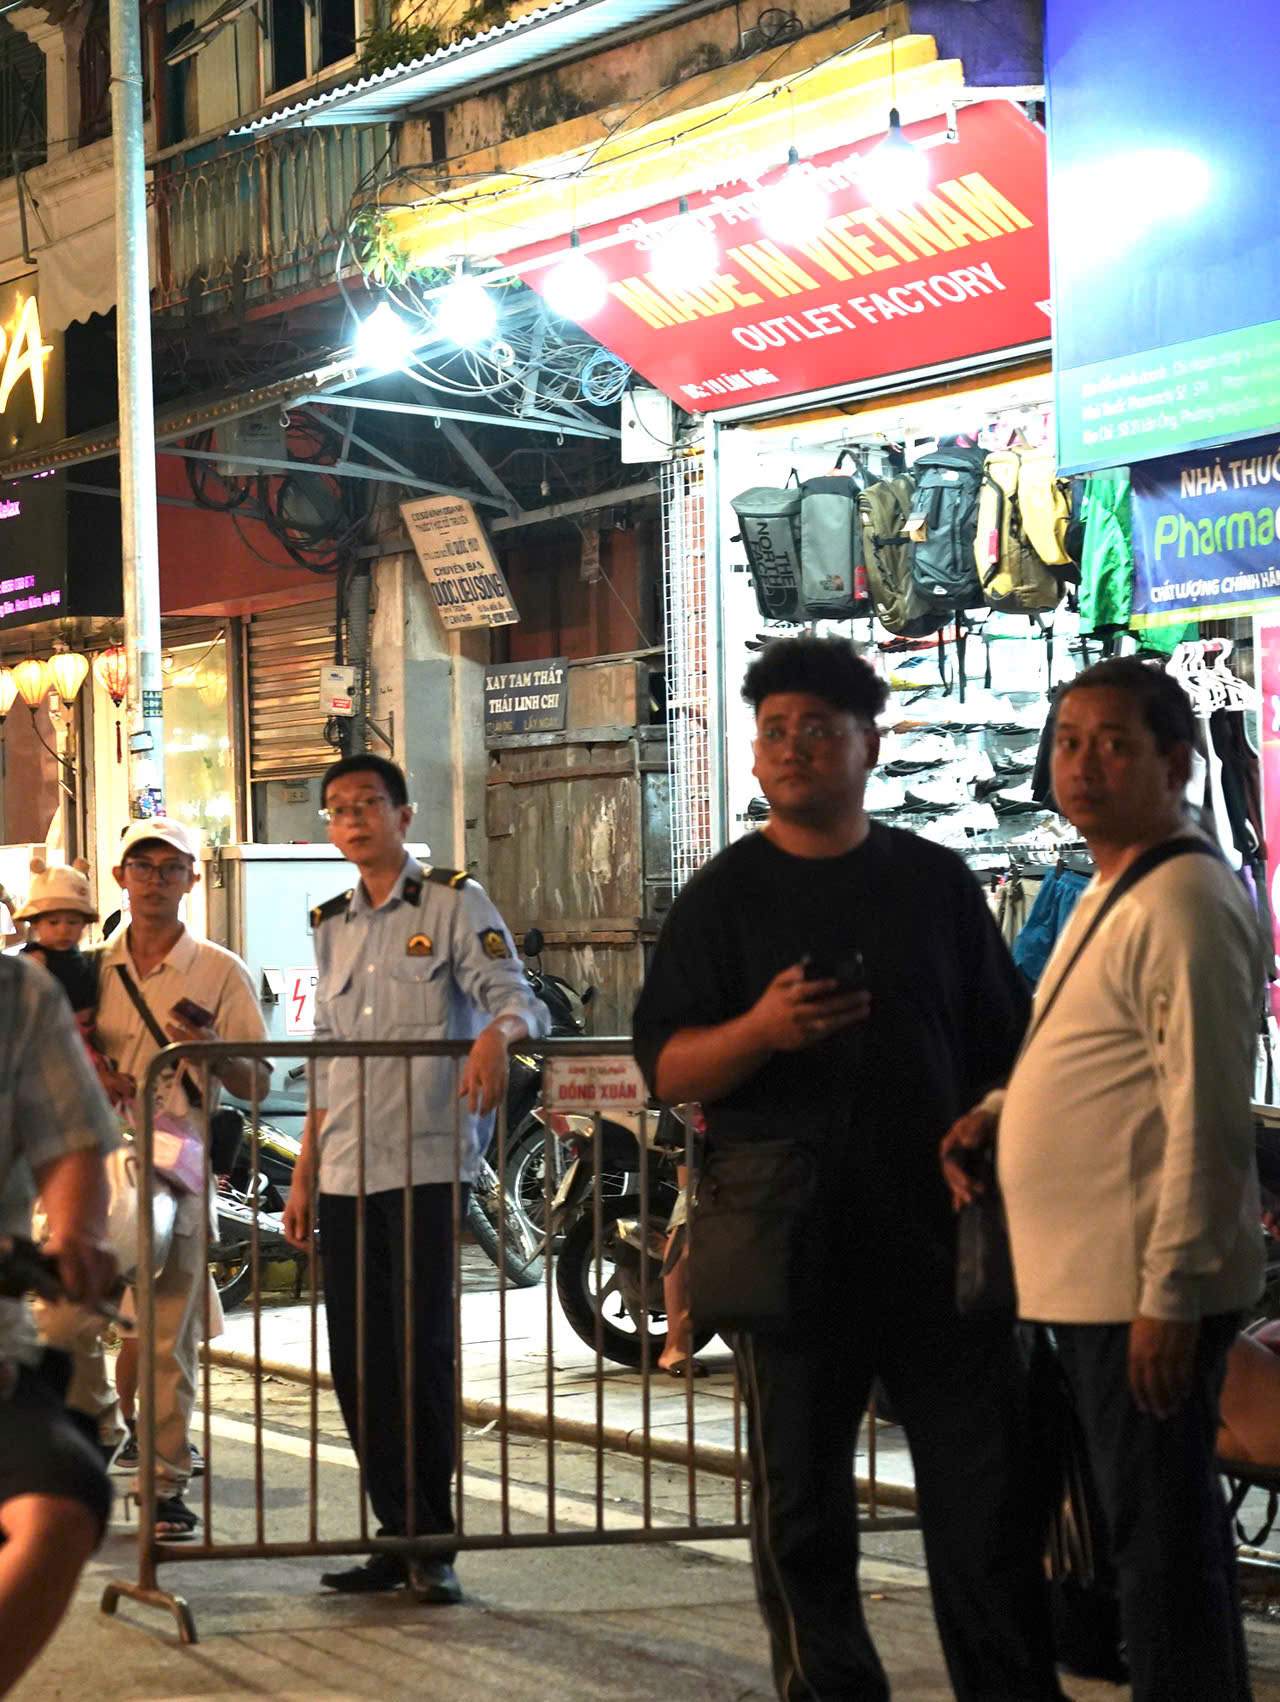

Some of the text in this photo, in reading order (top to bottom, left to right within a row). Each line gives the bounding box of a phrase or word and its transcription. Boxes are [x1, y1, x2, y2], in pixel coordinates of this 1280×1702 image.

[728, 239, 821, 298] IN
[802, 171, 1034, 282] VIETNAM
[732, 262, 1008, 352] OUTLET FACTORY
[1180, 456, 1228, 500] NHÀ
[757, 522, 784, 586] NORTH
[1154, 505, 1280, 561] Pharma
[775, 551, 796, 586] THE
[486, 663, 564, 691] XAY TAM THẤT
[488, 693, 560, 714] THÁI LINH CHI
